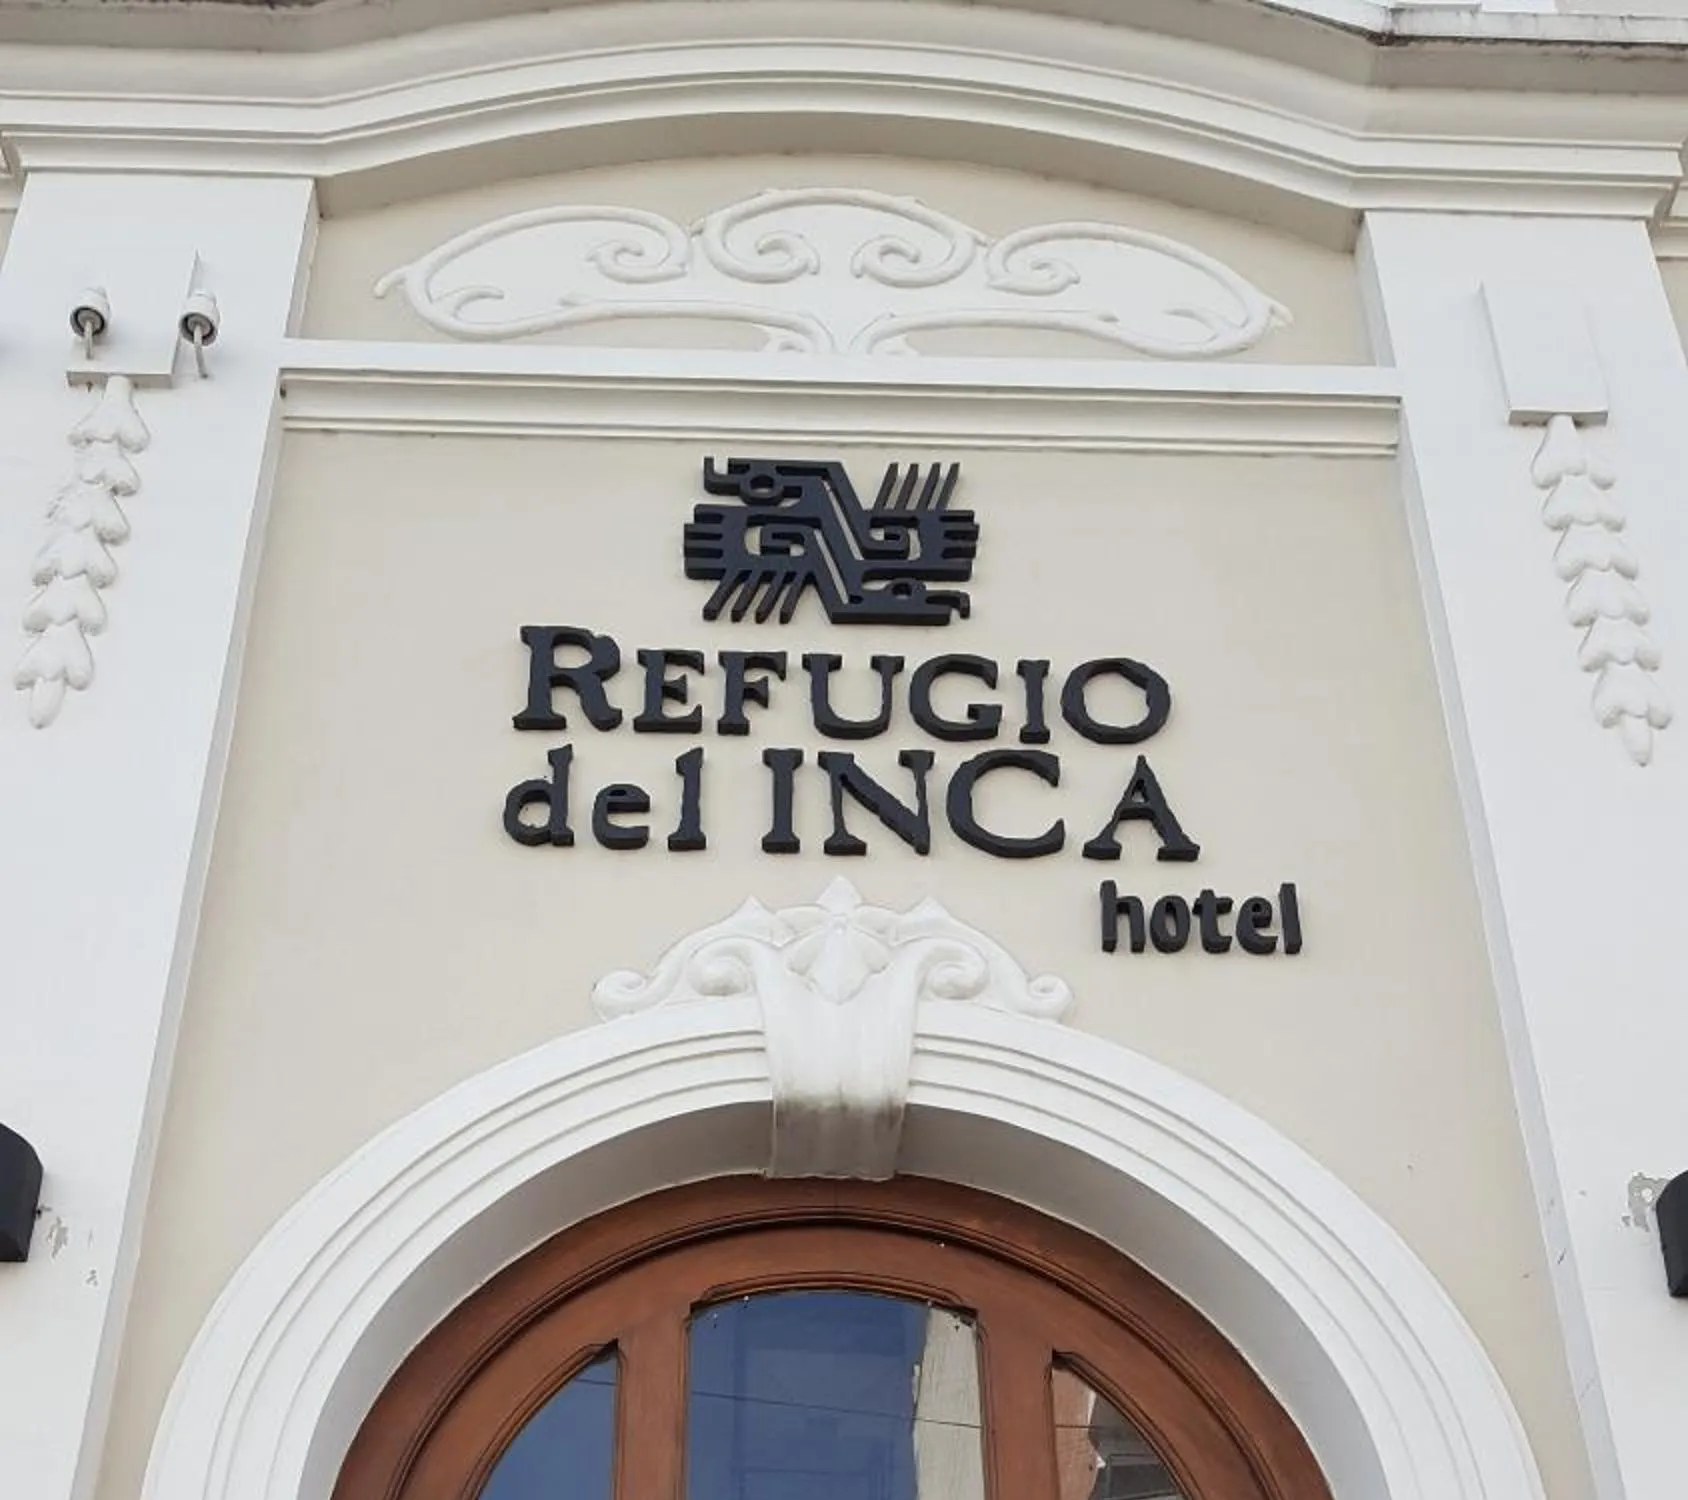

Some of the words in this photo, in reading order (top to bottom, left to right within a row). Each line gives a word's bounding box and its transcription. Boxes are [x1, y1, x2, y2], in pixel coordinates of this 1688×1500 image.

[512, 625, 1171, 745] REFUGIO
[503, 743, 707, 852] del
[761, 748, 1201, 862] INCA
[1100, 880, 1303, 955] hotel
